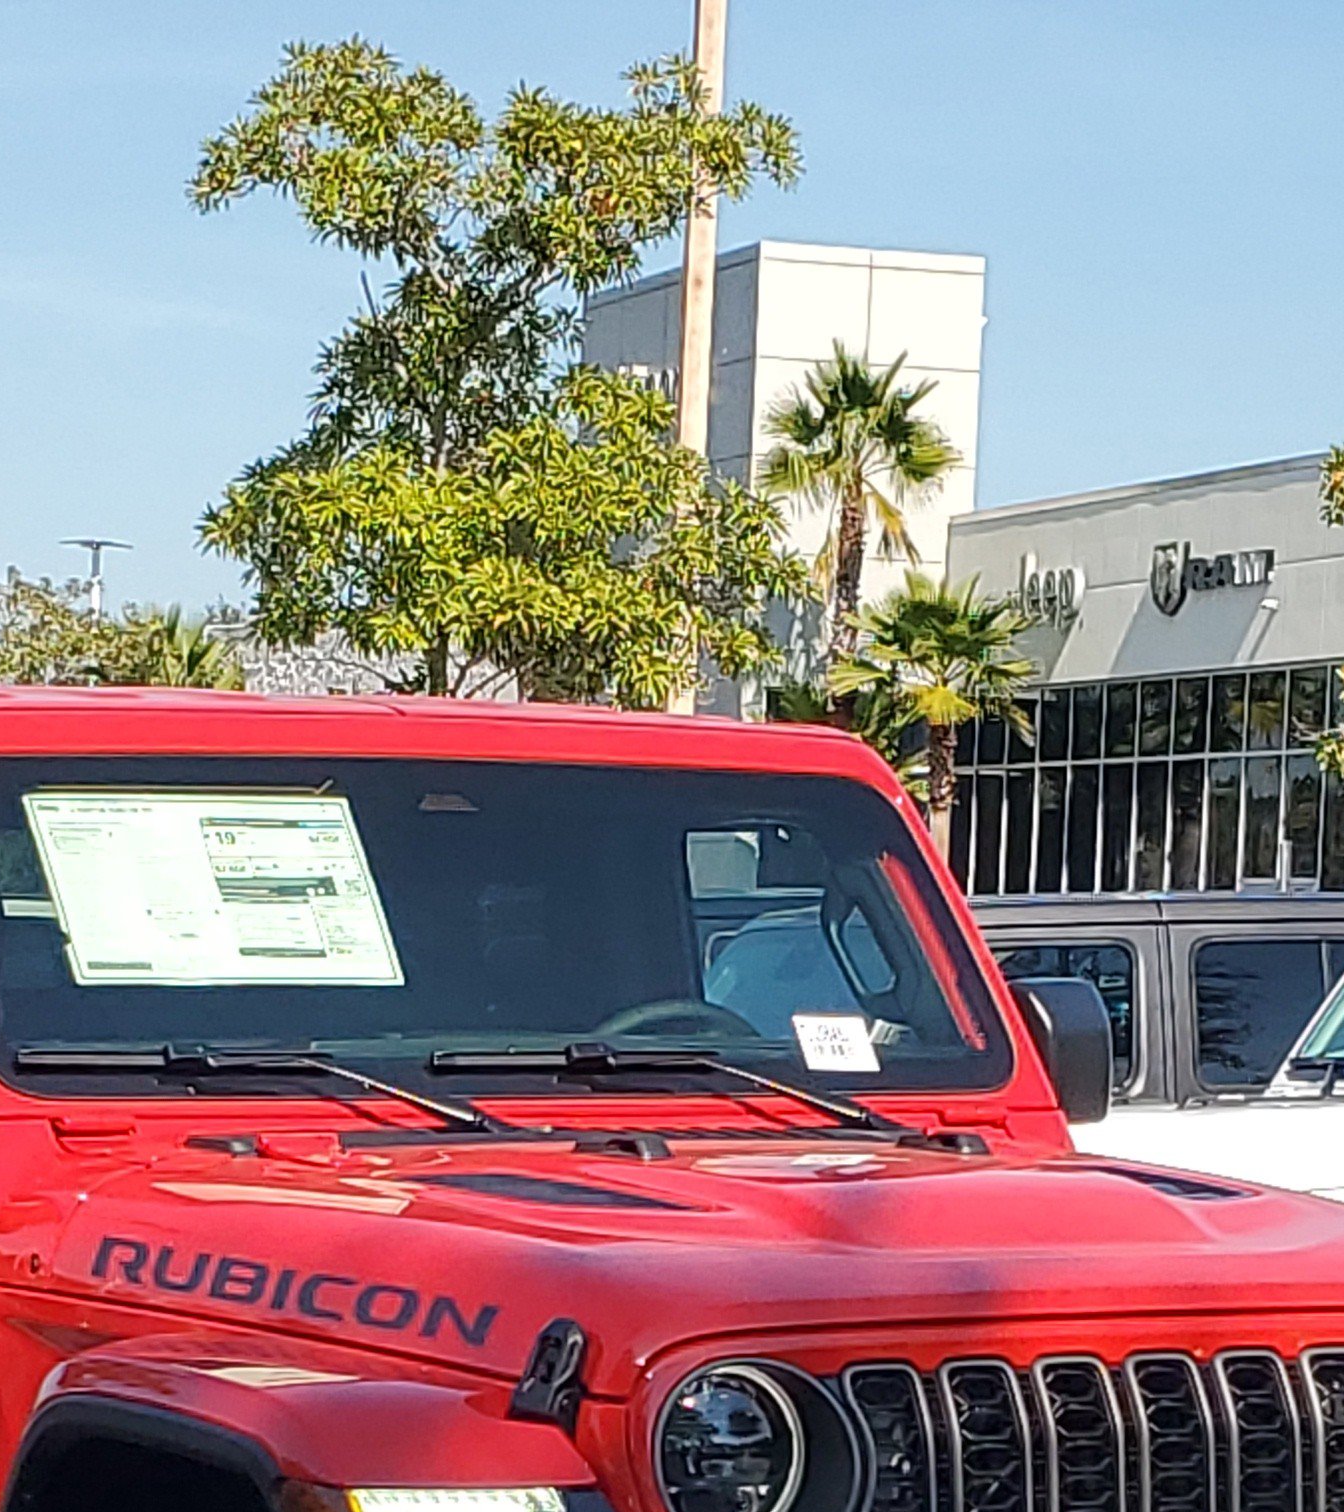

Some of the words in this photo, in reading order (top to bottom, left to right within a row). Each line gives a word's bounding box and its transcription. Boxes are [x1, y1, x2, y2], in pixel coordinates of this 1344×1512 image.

[1014, 552, 1086, 630] Jeep
[1188, 551, 1274, 589] RAM
[91, 1235, 501, 1346] RUBICON
